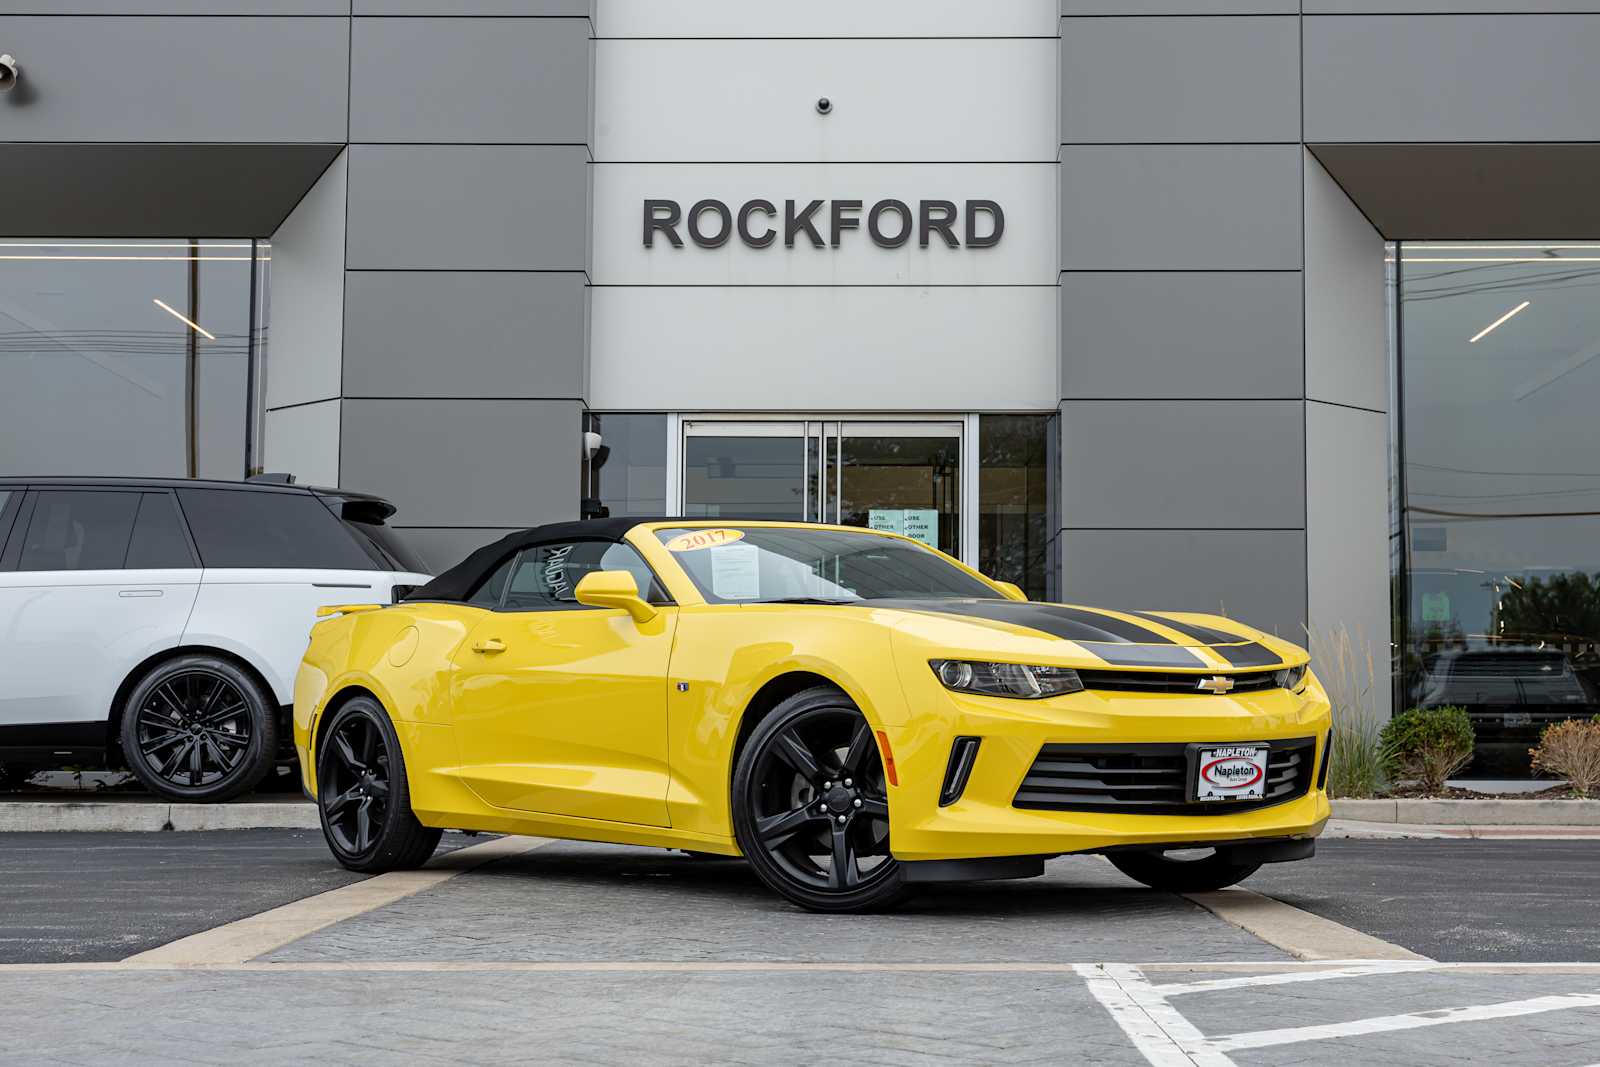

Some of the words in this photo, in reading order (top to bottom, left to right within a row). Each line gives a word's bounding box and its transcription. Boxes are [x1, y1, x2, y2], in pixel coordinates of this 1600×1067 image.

[642, 198, 1006, 249] ROCKFORD
[680, 529, 728, 550] 2017
[1215, 764, 1254, 778] Napleton
